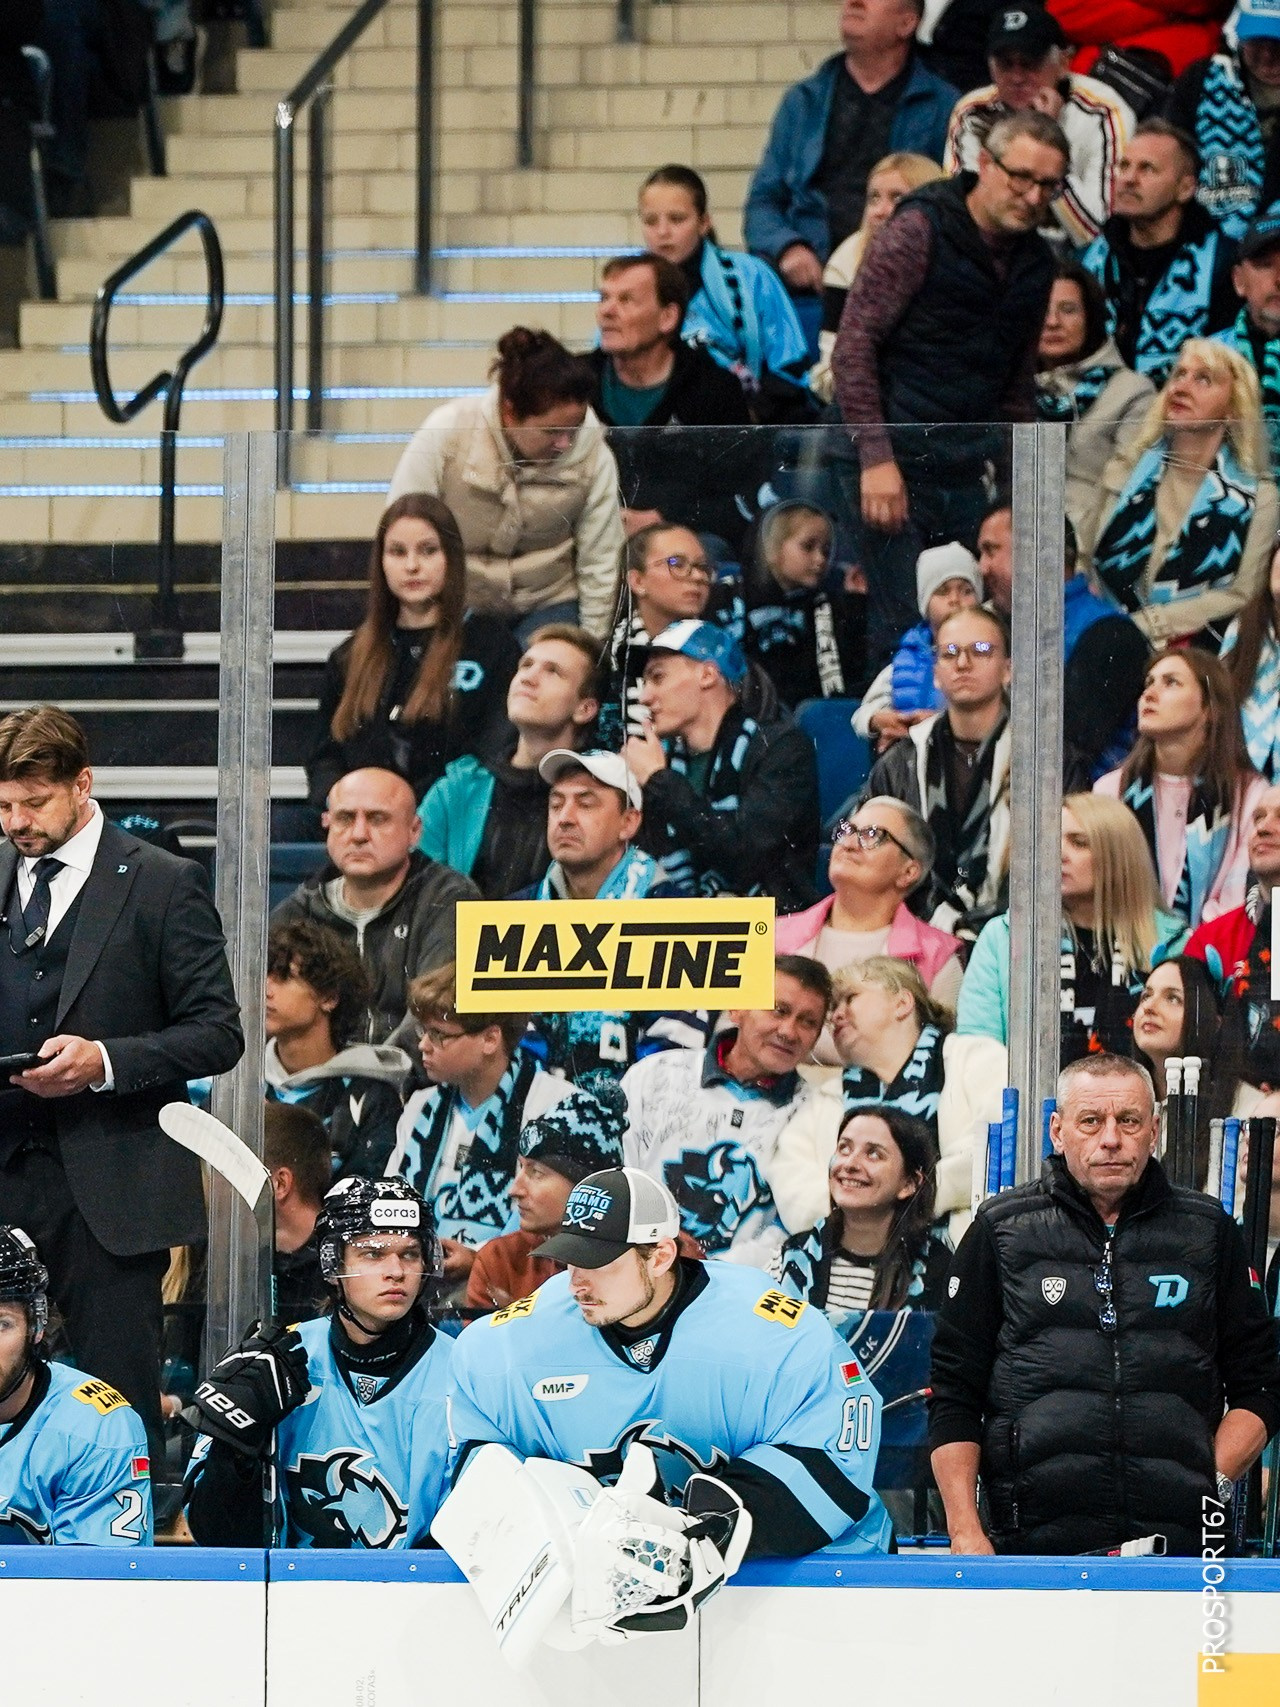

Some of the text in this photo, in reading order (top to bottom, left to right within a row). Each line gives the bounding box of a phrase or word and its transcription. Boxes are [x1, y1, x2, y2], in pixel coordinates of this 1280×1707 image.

[374, 1208, 417, 1219] согаз
[541, 1382, 575, 1395] МИР
[836, 1395, 875, 1452] 60
[110, 1488, 148, 1541] 2
[496, 1553, 550, 1632] TRUE
